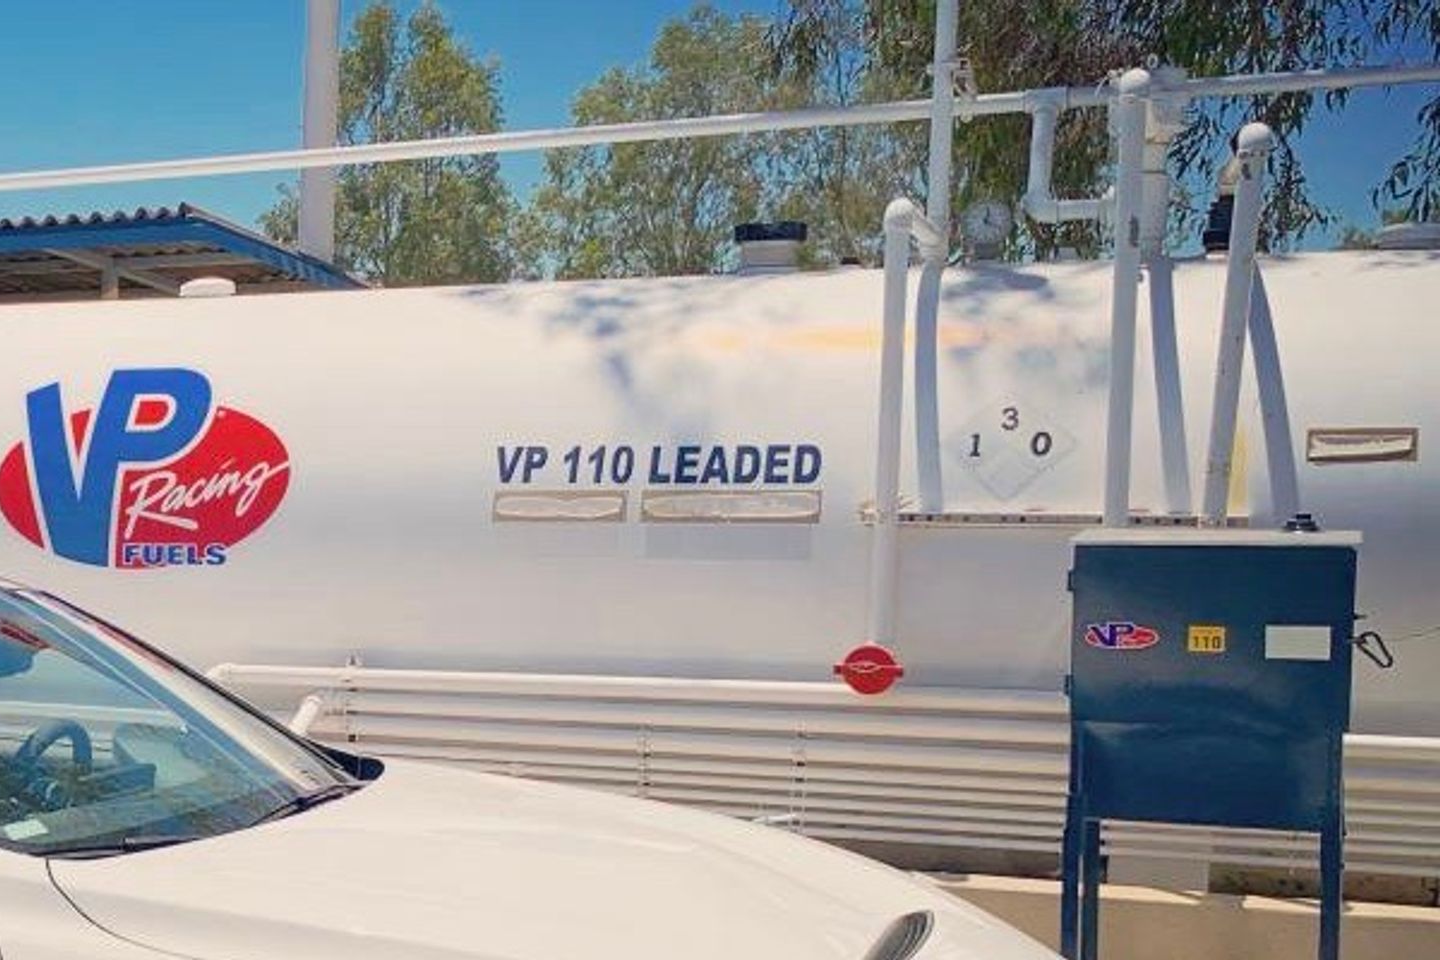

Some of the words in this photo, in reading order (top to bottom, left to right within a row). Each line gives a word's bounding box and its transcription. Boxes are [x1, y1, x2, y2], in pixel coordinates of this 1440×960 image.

[1000, 406, 1020, 431] 3
[970, 433, 981, 457] 1
[1031, 431, 1053, 456] 0
[26, 367, 212, 568] VP
[497, 446, 548, 484] VP
[563, 446, 635, 484] 110
[647, 445, 823, 484] LEADED
[124, 459, 290, 540] Racing
[124, 544, 228, 565] FUELS
[1089, 623, 1134, 646] VP
[1193, 635, 1221, 649] 110
